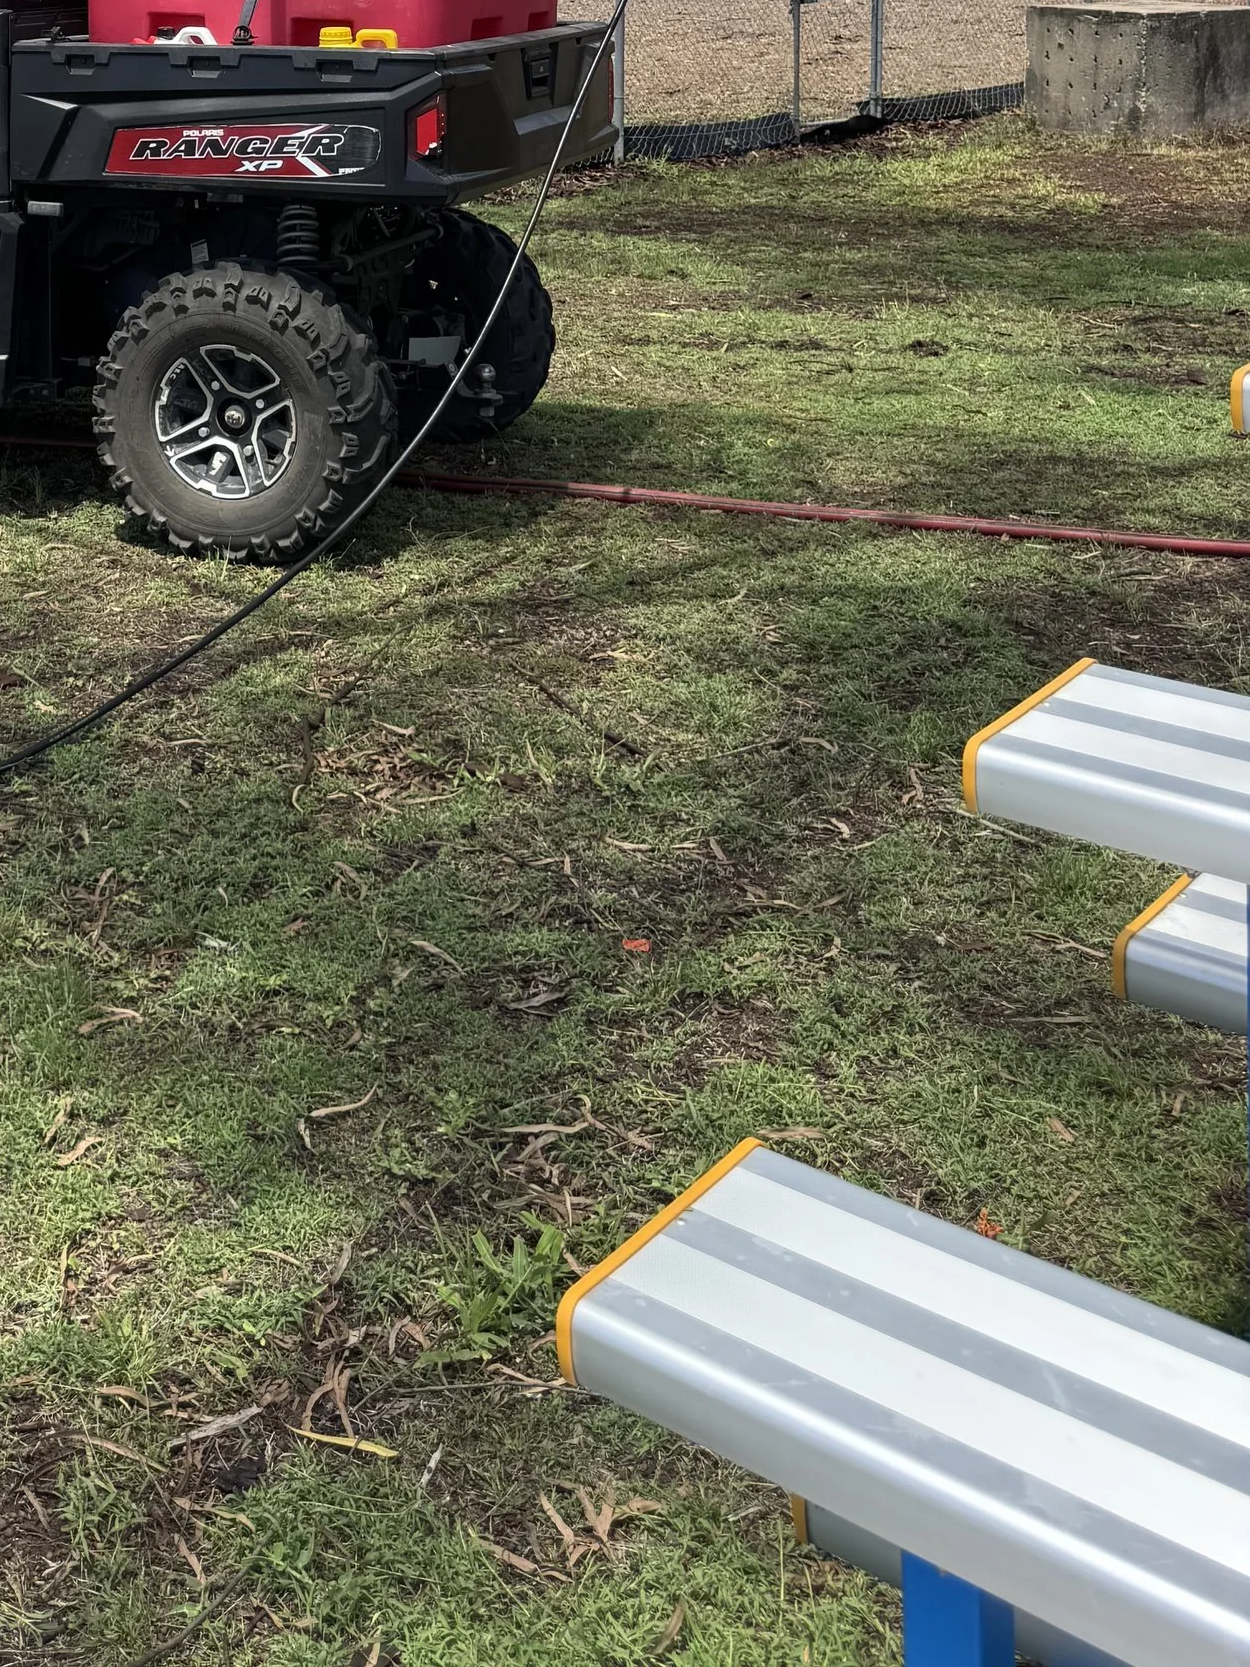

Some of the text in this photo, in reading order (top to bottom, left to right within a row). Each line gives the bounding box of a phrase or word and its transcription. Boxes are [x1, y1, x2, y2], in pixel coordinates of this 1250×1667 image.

[182, 129, 224, 137] POLARIS
[129, 133, 344, 160] RANGER
[234, 159, 283, 172] XP
